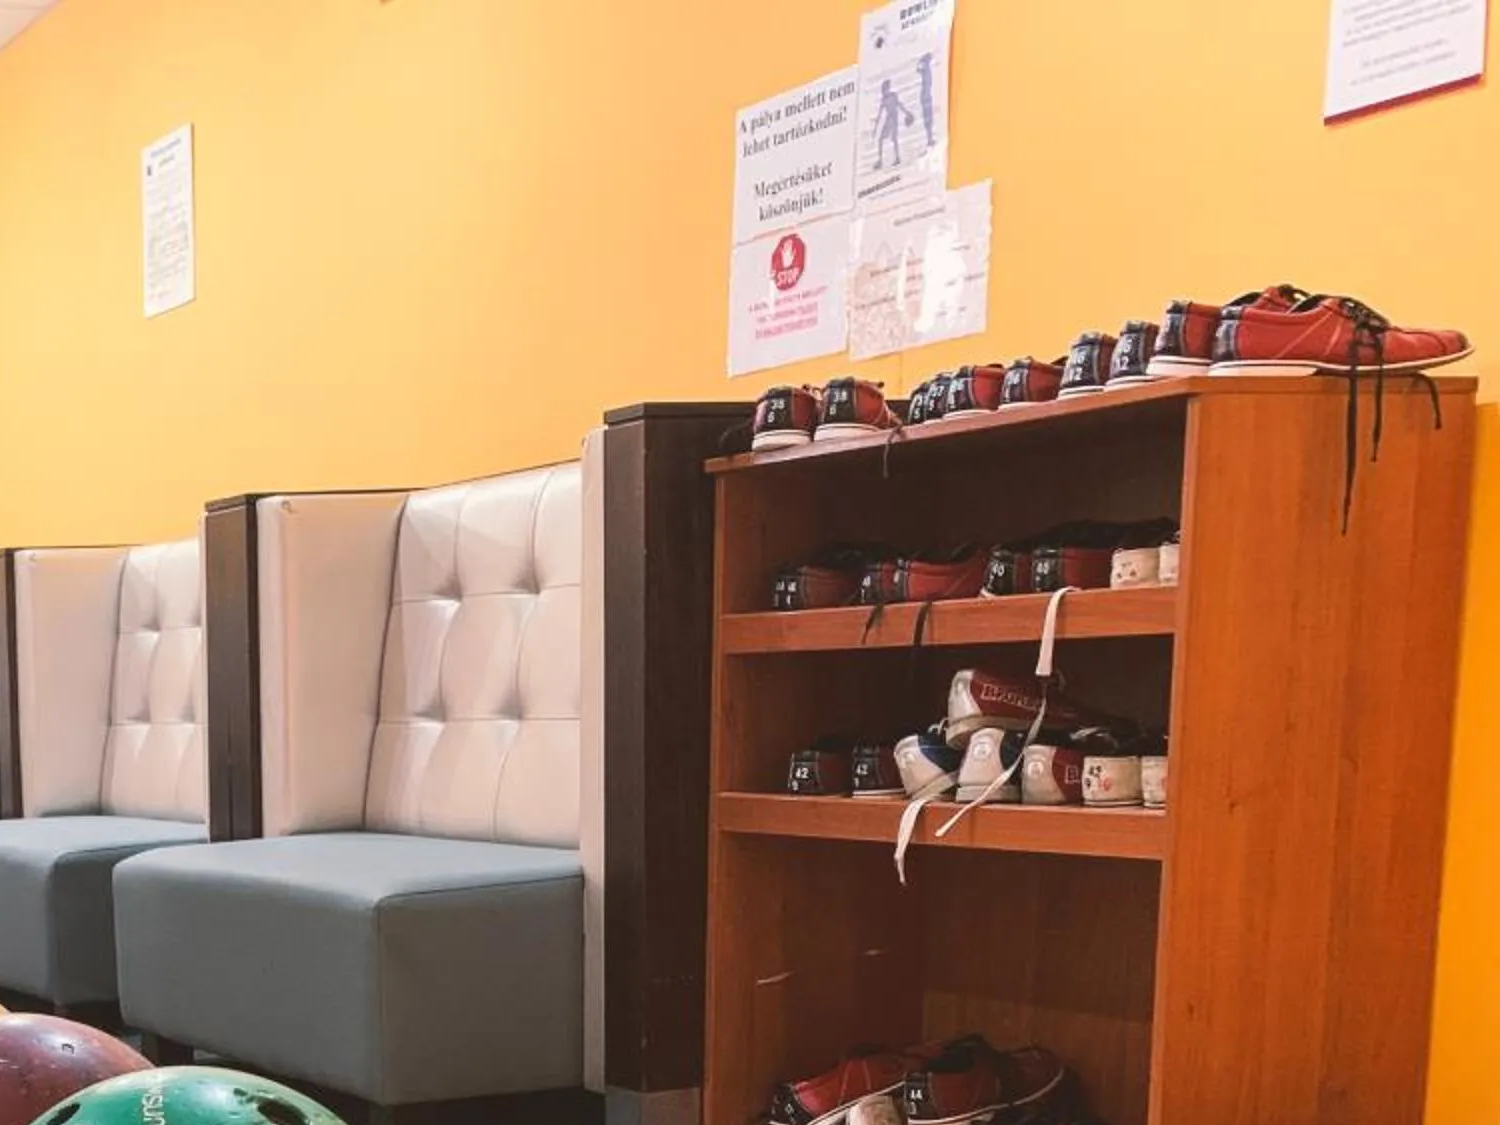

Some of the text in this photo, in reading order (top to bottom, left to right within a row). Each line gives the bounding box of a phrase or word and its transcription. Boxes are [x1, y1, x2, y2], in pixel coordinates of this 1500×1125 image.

[739, 81, 855, 135] A pálya mellett nem
[742, 135, 770, 158] lehet
[775, 267, 799, 287] STOP
